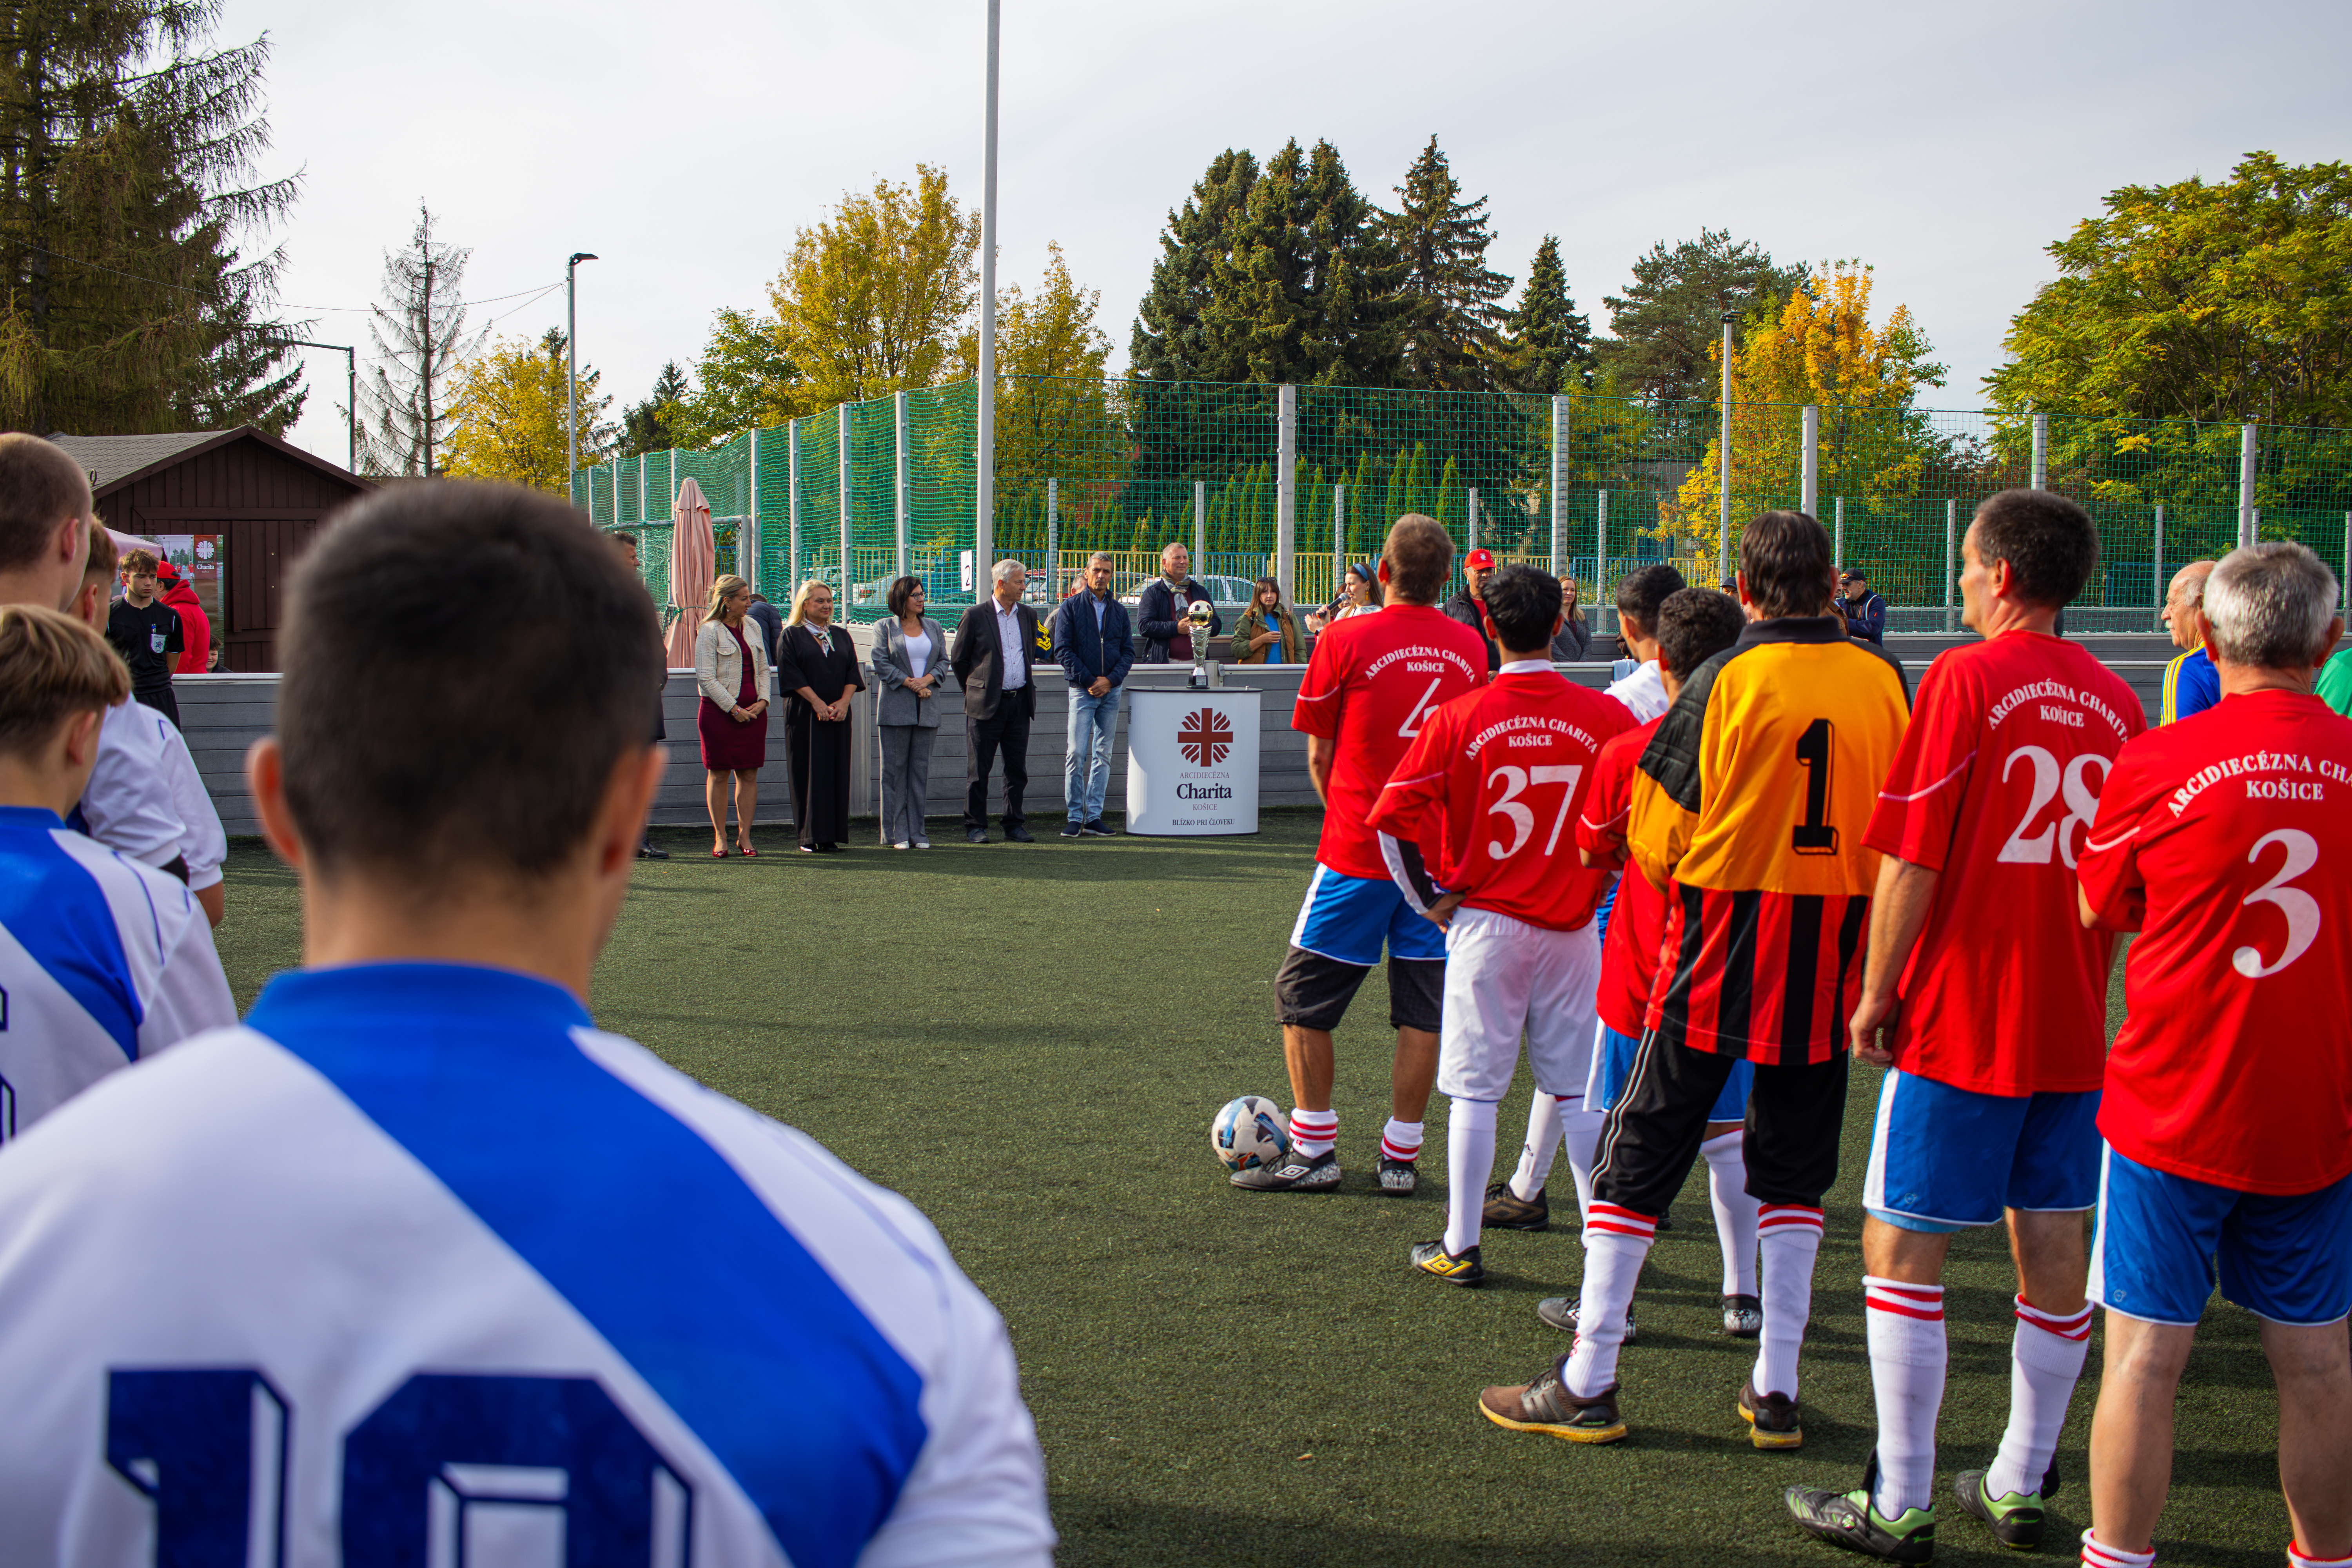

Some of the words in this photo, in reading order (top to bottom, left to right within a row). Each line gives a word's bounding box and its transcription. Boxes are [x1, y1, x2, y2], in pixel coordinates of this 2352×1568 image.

[965, 565, 970, 586] 2
[1365, 644, 1440, 680] ARCIDIECÉZNA
[1442, 649, 1475, 683] CHARITA
[1406, 660, 1445, 673] KOŠICE
[1398, 677, 1441, 737] 4
[1988, 678, 2077, 731] ARCIDIECÉZNA
[1465, 715, 1546, 760] ARCIDIECÉZNA
[1548, 718, 1598, 754] CHARITA
[1508, 733, 1553, 747] KOŠICE
[1176, 782, 1232, 799] Charita
[1180, 770, 1230, 779] ARCIDIECÉZNA
[1792, 718, 1838, 855] 1
[2168, 750, 2313, 818] ARCIDIECÉZNA
[2246, 777, 2323, 800] KOŠICE
[1192, 802, 1217, 811] KOŠICE
[1488, 765, 1583, 860] 37
[1996, 745, 2113, 870] 28
[2232, 828, 2320, 978] 3
